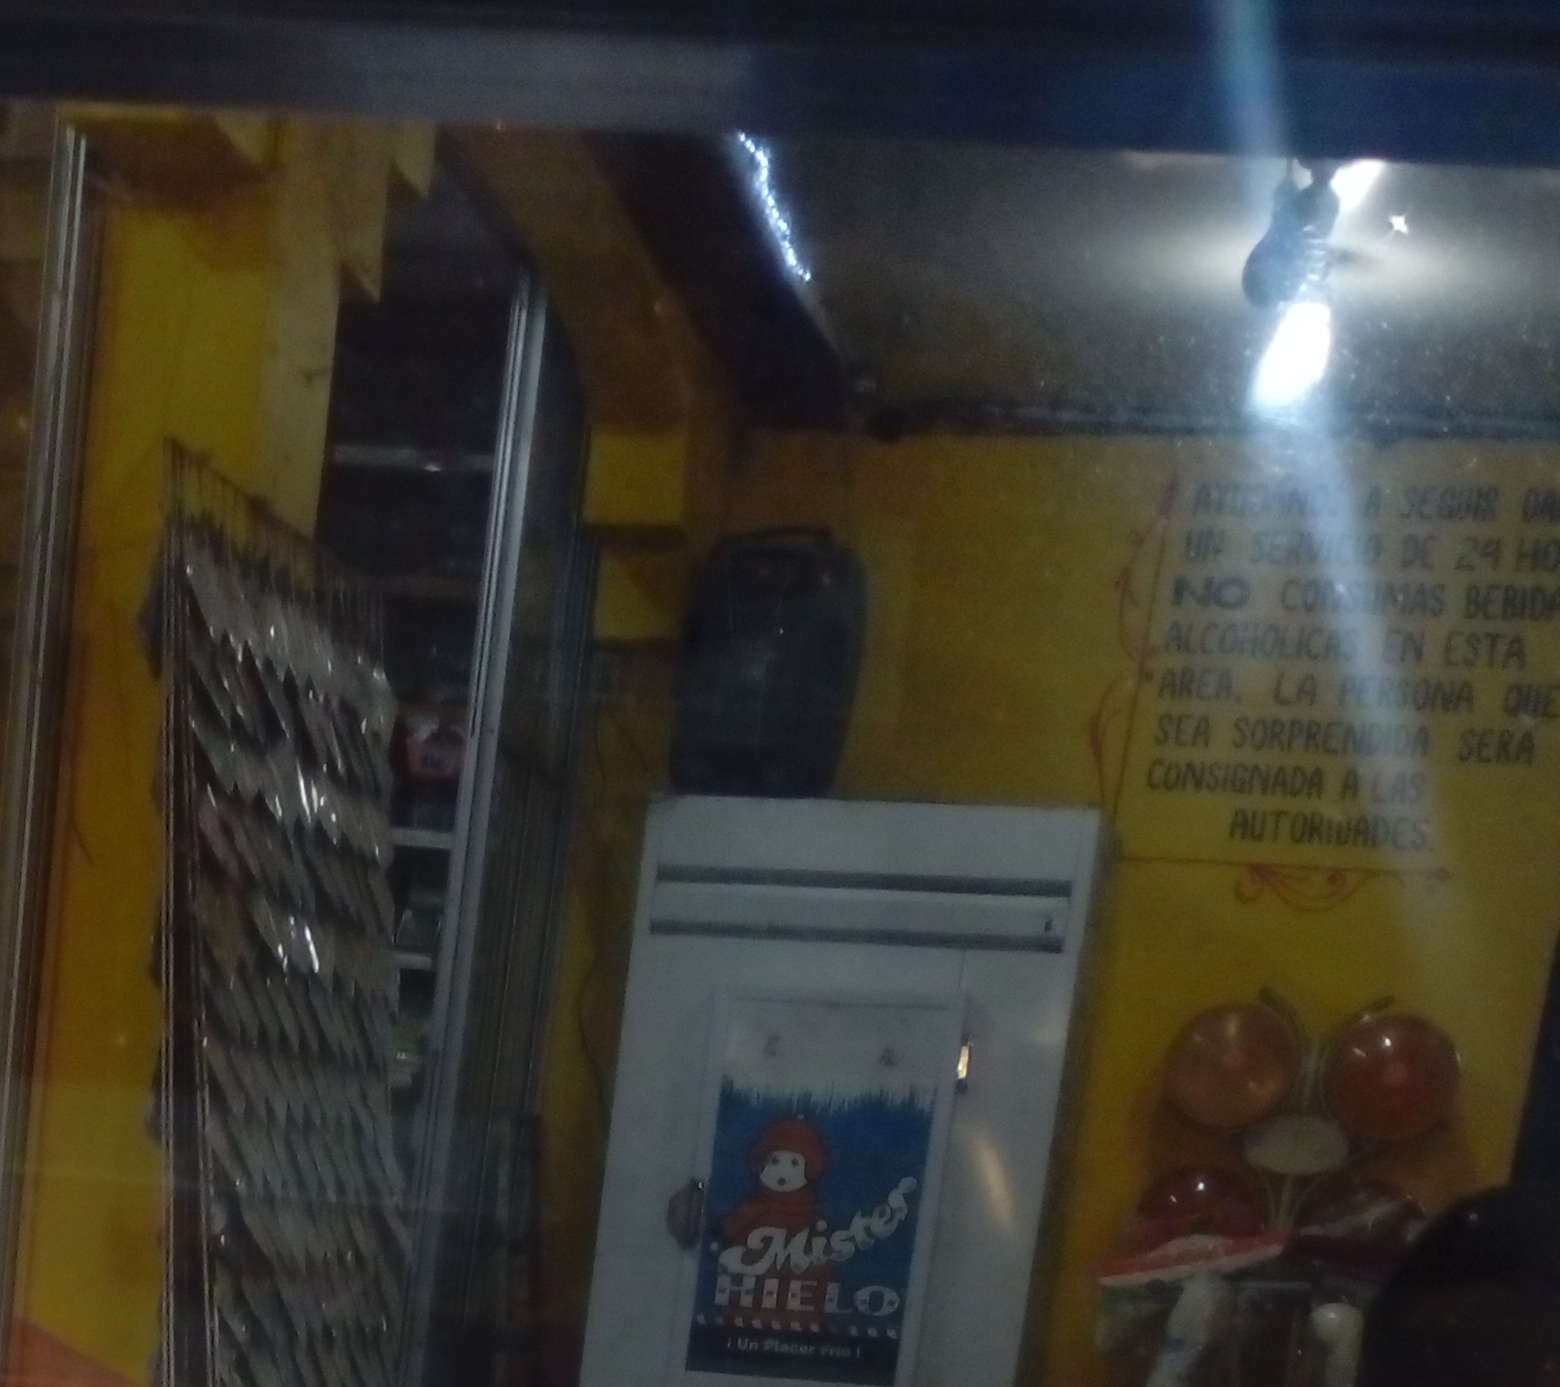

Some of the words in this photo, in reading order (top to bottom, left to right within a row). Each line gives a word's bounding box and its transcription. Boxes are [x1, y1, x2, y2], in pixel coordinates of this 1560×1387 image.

[1401, 533, 1437, 568] DE
[1454, 537, 1501, 572] 24
[1172, 576, 1251, 610] NO
[1280, 576, 1445, 618] CONSUMAS
[1164, 621, 1358, 662] ALCOHOLICAS
[1383, 628, 1425, 665] EN
[1443, 630, 1527, 672] ESTA
[1273, 672, 1318, 707] LA
[1338, 676, 1475, 716] PERSONA
[1153, 712, 1212, 749] SEA
[1231, 715, 1431, 759] SORPRENDIDA
[1456, 728, 1537, 766] SERA
[1145, 758, 1325, 799] CONSIGNADA
[1340, 768, 1360, 799] A
[1371, 770, 1427, 806] LAS
[717, 1176, 918, 1275] Mister
[714, 1274, 901, 1318] HIELO
